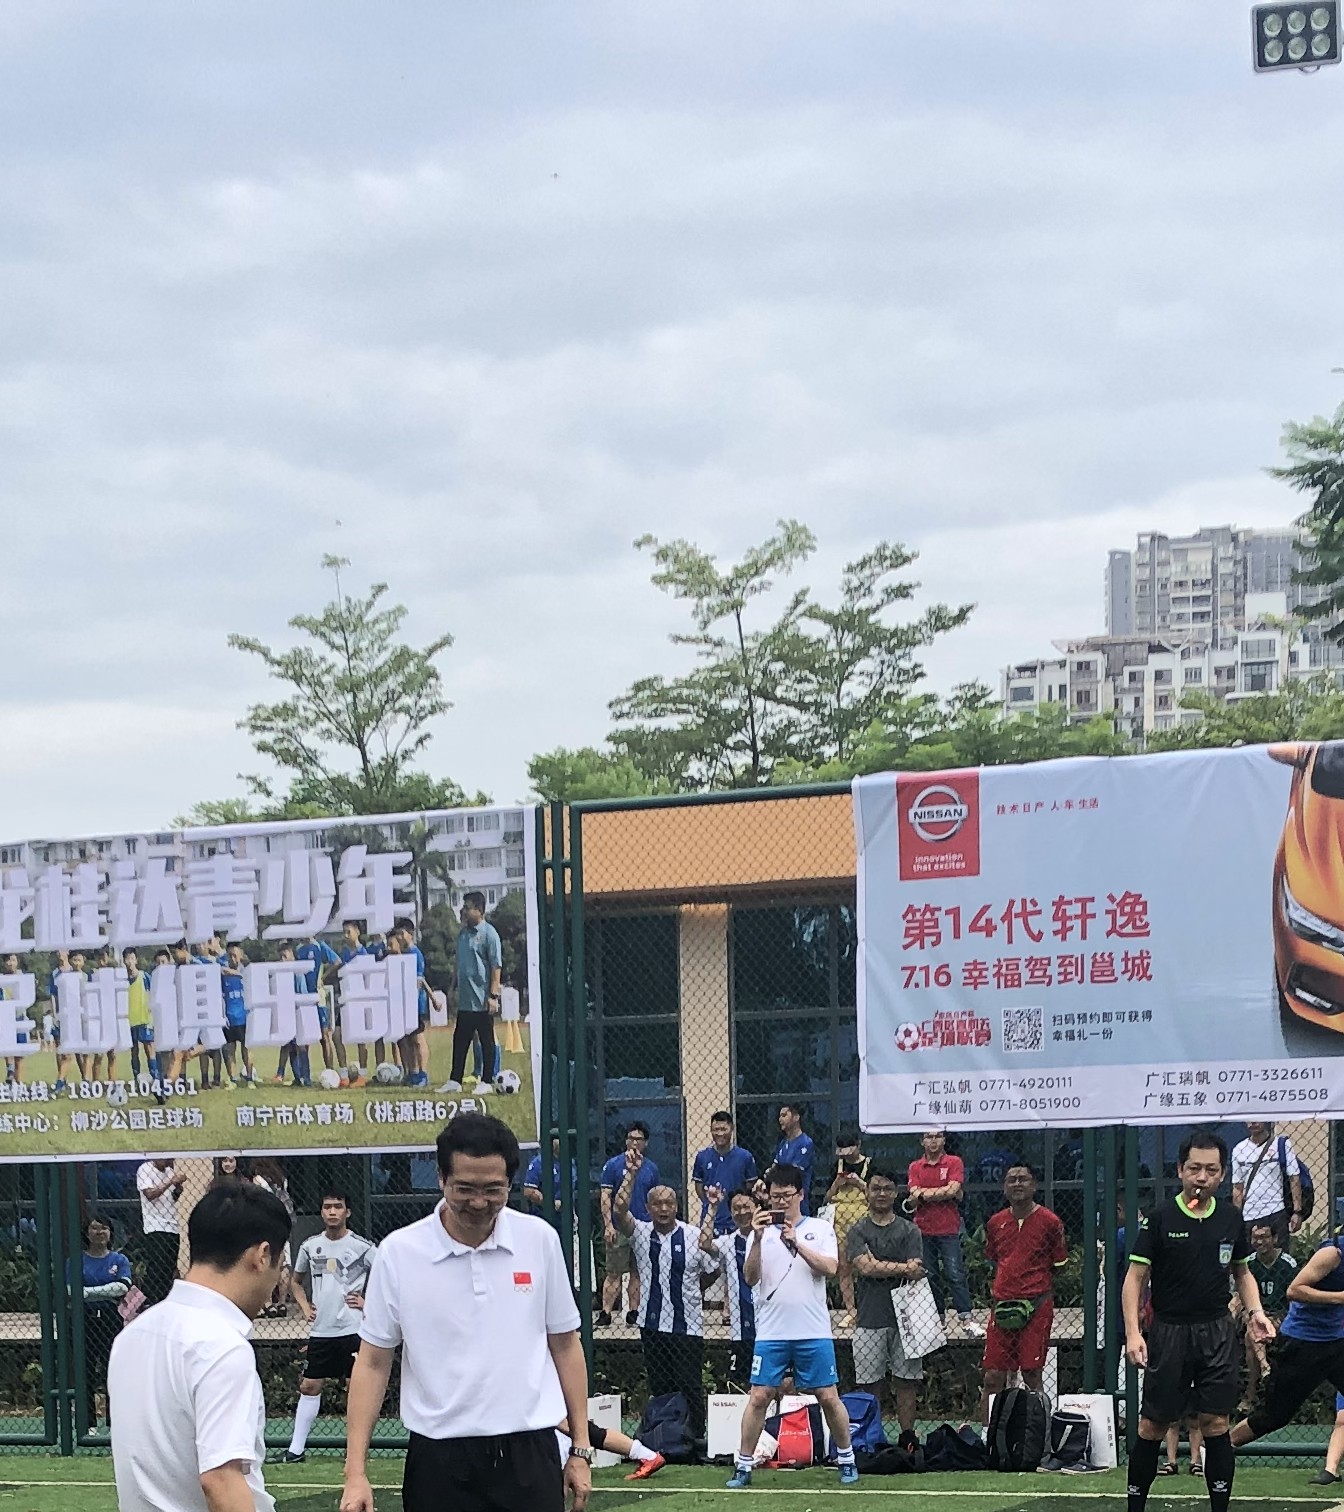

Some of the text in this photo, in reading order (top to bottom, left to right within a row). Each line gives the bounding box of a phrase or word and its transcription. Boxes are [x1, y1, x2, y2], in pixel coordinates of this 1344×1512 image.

[913, 808, 963, 820] NISSAN
[901, 890, 1151, 951] 第14代轩逸
[901, 949, 1153, 991] 7.16 幸福驾到邕城
[1052, 1010, 1153, 1027] 扫码预约即可获得
[1052, 1028, 1114, 1042] 幸福礼一份
[913, 1076, 1073, 1095] 广汇弘帆 0771-4920111
[1146, 1067, 1324, 1087] 广汇瑞帆 0771-3326611
[913, 1096, 1081, 1116] 广缘仙葫 0771-8051900
[1143, 1088, 1329, 1108] 广缘五象 0771-4875508
